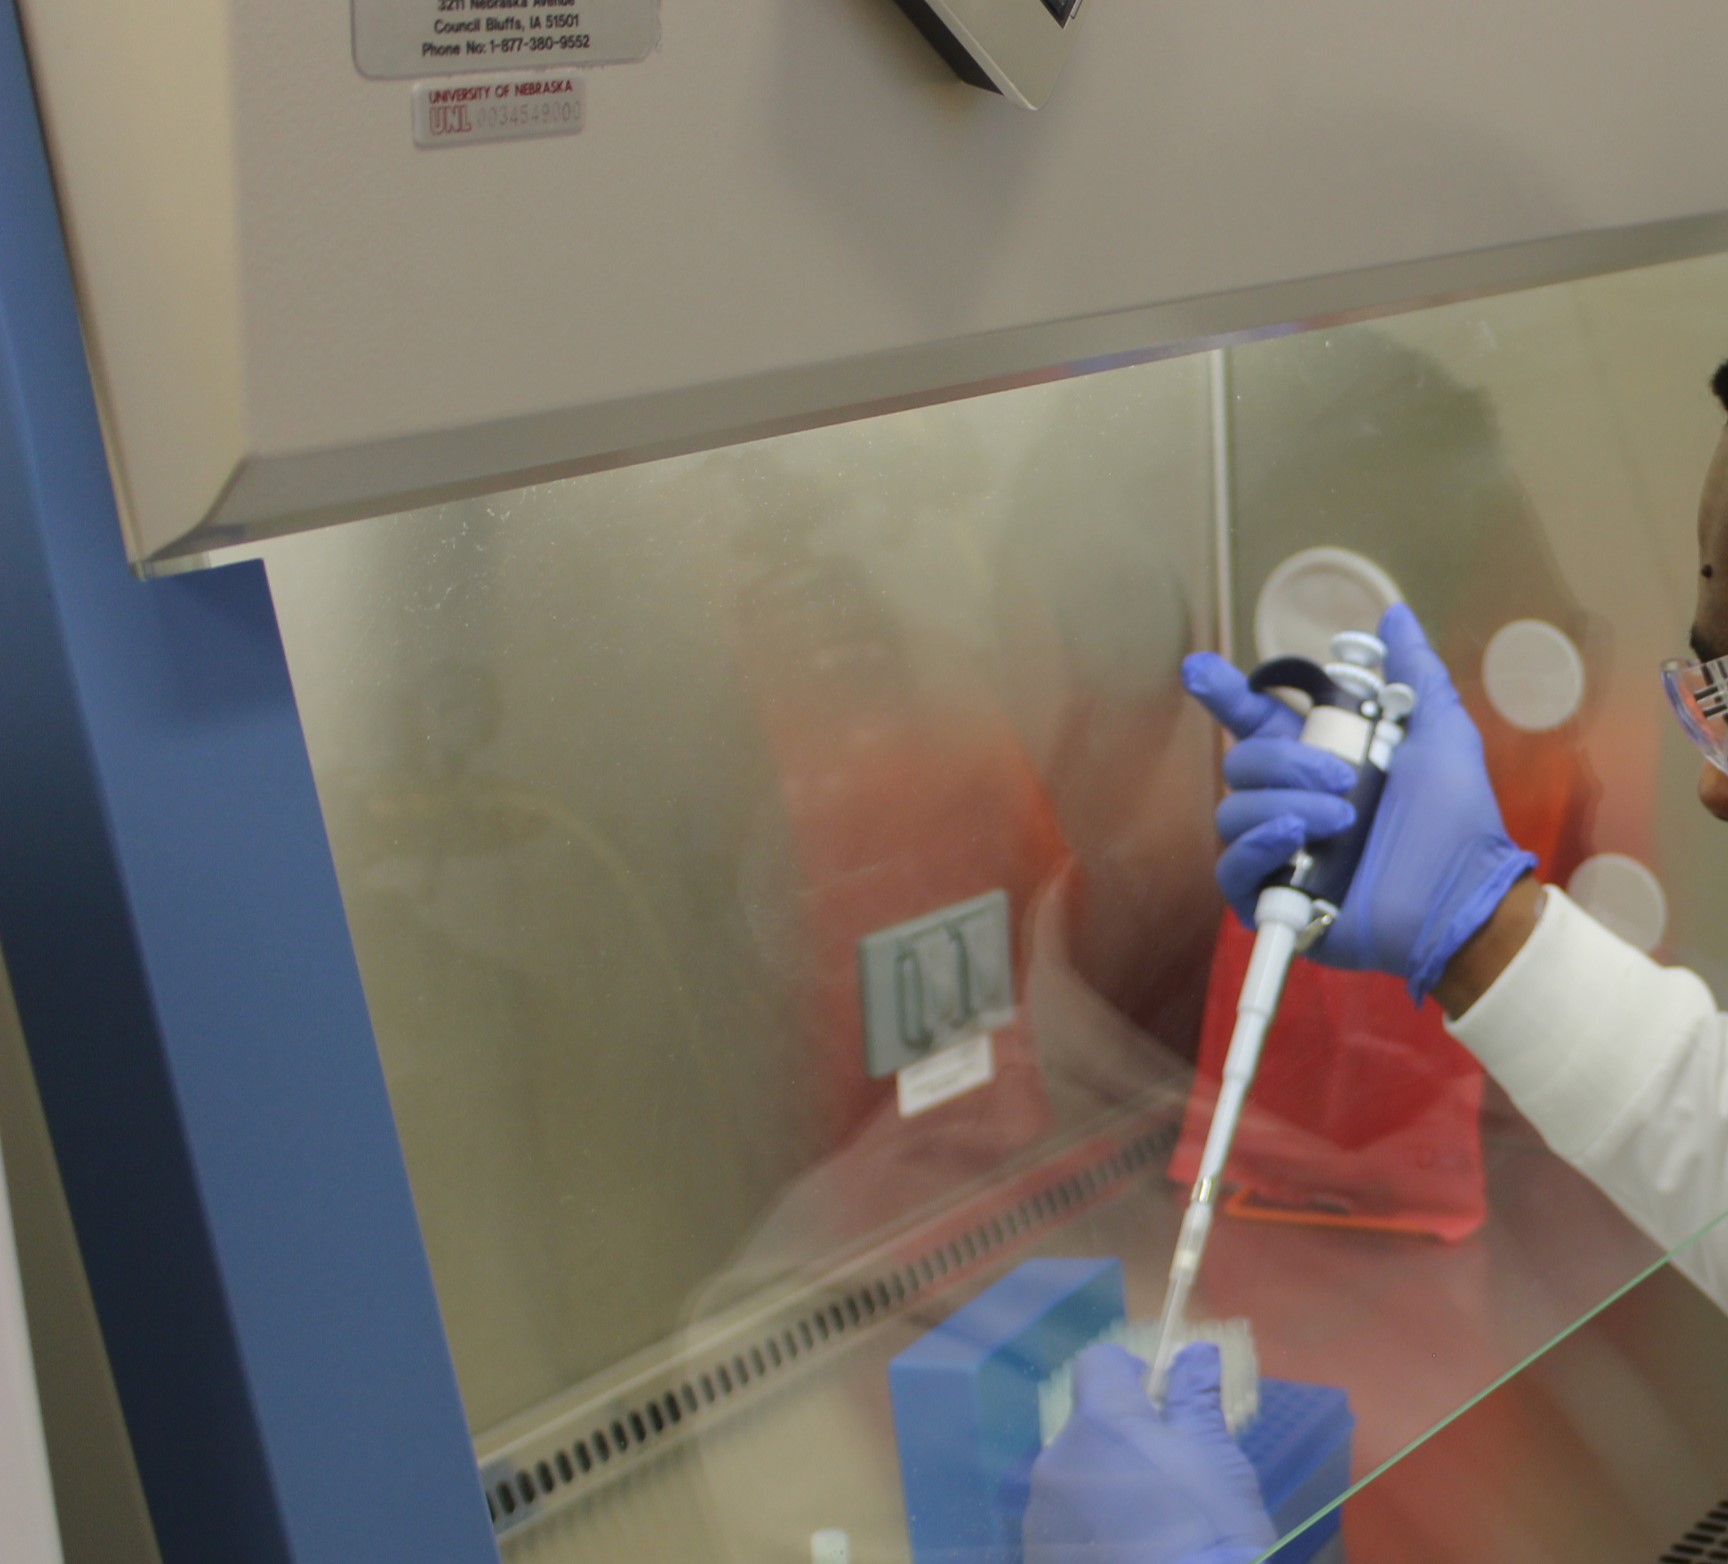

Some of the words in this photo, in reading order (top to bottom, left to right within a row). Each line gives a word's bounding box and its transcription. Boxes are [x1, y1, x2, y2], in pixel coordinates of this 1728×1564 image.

[438, 0, 465, 11] 3211
[470, 0, 528, 10] Nebraska
[434, 18, 480, 34] Council
[486, 16, 525, 32] Bluffs,
[530, 15, 541, 29] IA
[546, 13, 579, 29] 51501
[422, 42, 460, 57] Phone
[490, 34, 590, 53] 1-877-380-9552
[428, 86, 491, 104] UNIVERSITY
[495, 84, 511, 98] OF
[515, 79, 573, 96] NEBRASKA
[429, 104, 472, 135] UNL
